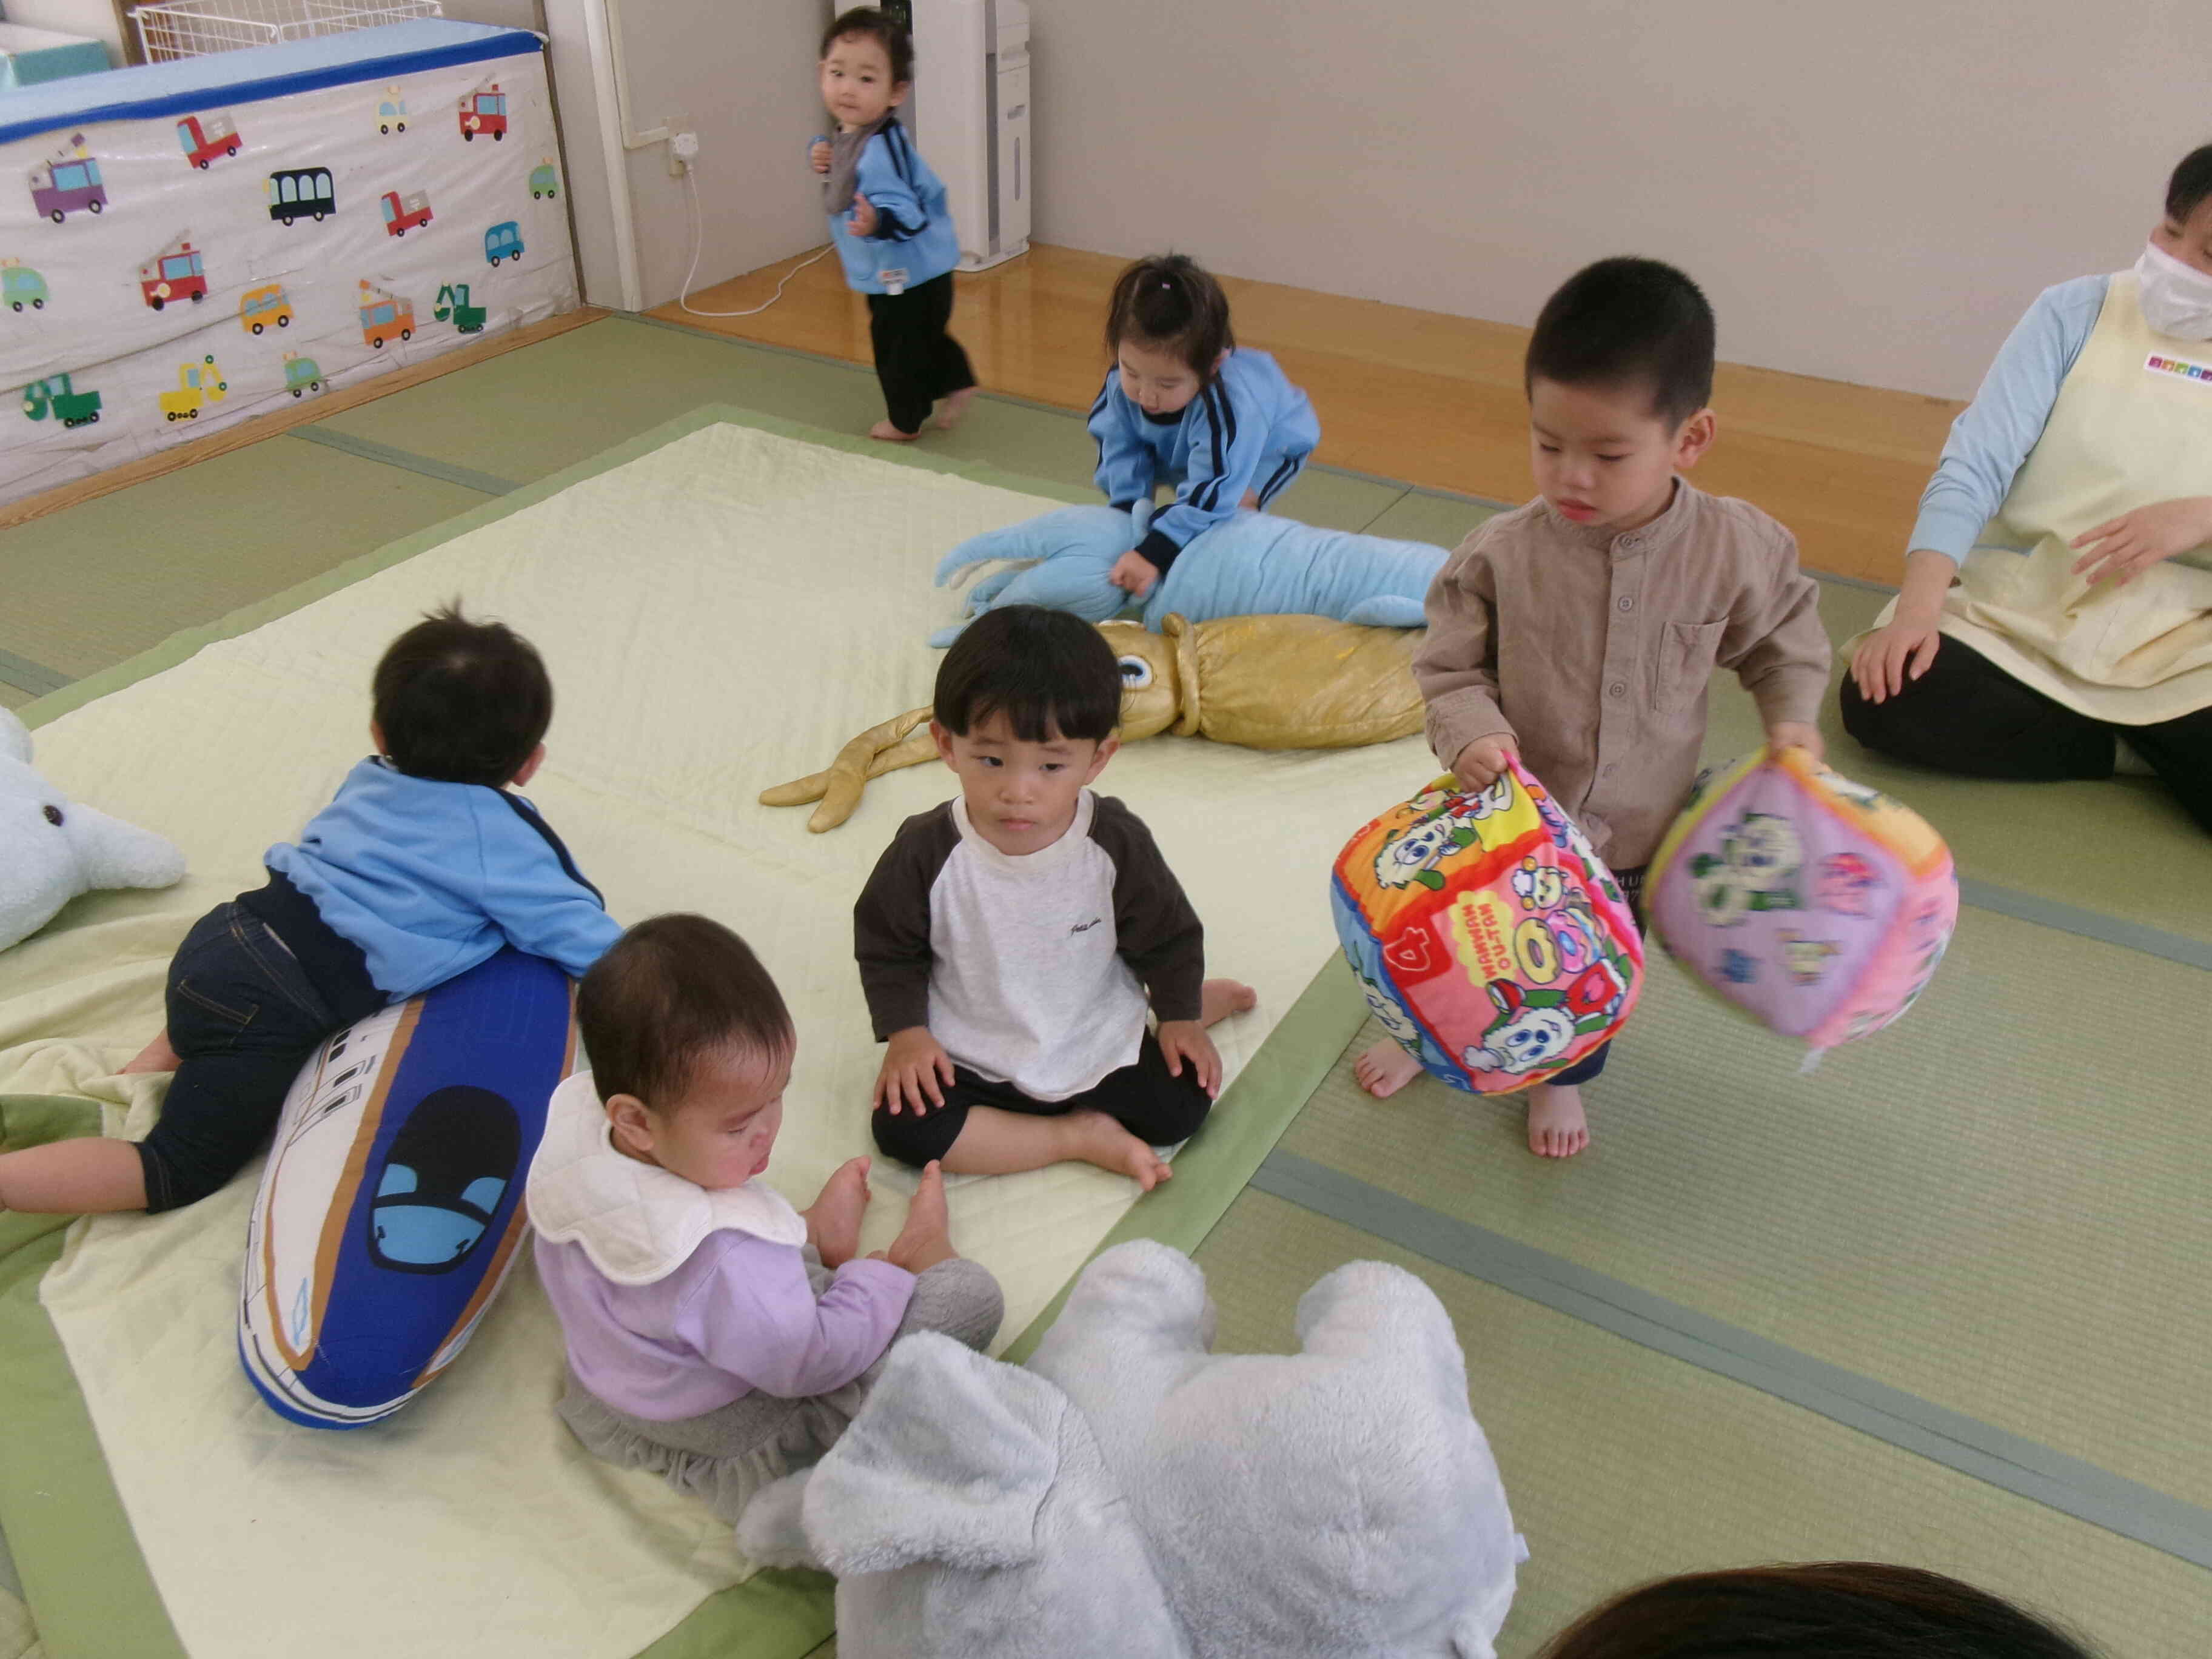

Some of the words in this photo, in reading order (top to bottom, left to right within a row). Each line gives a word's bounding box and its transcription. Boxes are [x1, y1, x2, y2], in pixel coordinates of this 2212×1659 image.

[1383, 927, 1431, 972] 4
[1462, 903, 1498, 979] WANWAN
[1477, 903, 1511, 970] OU-TAN
